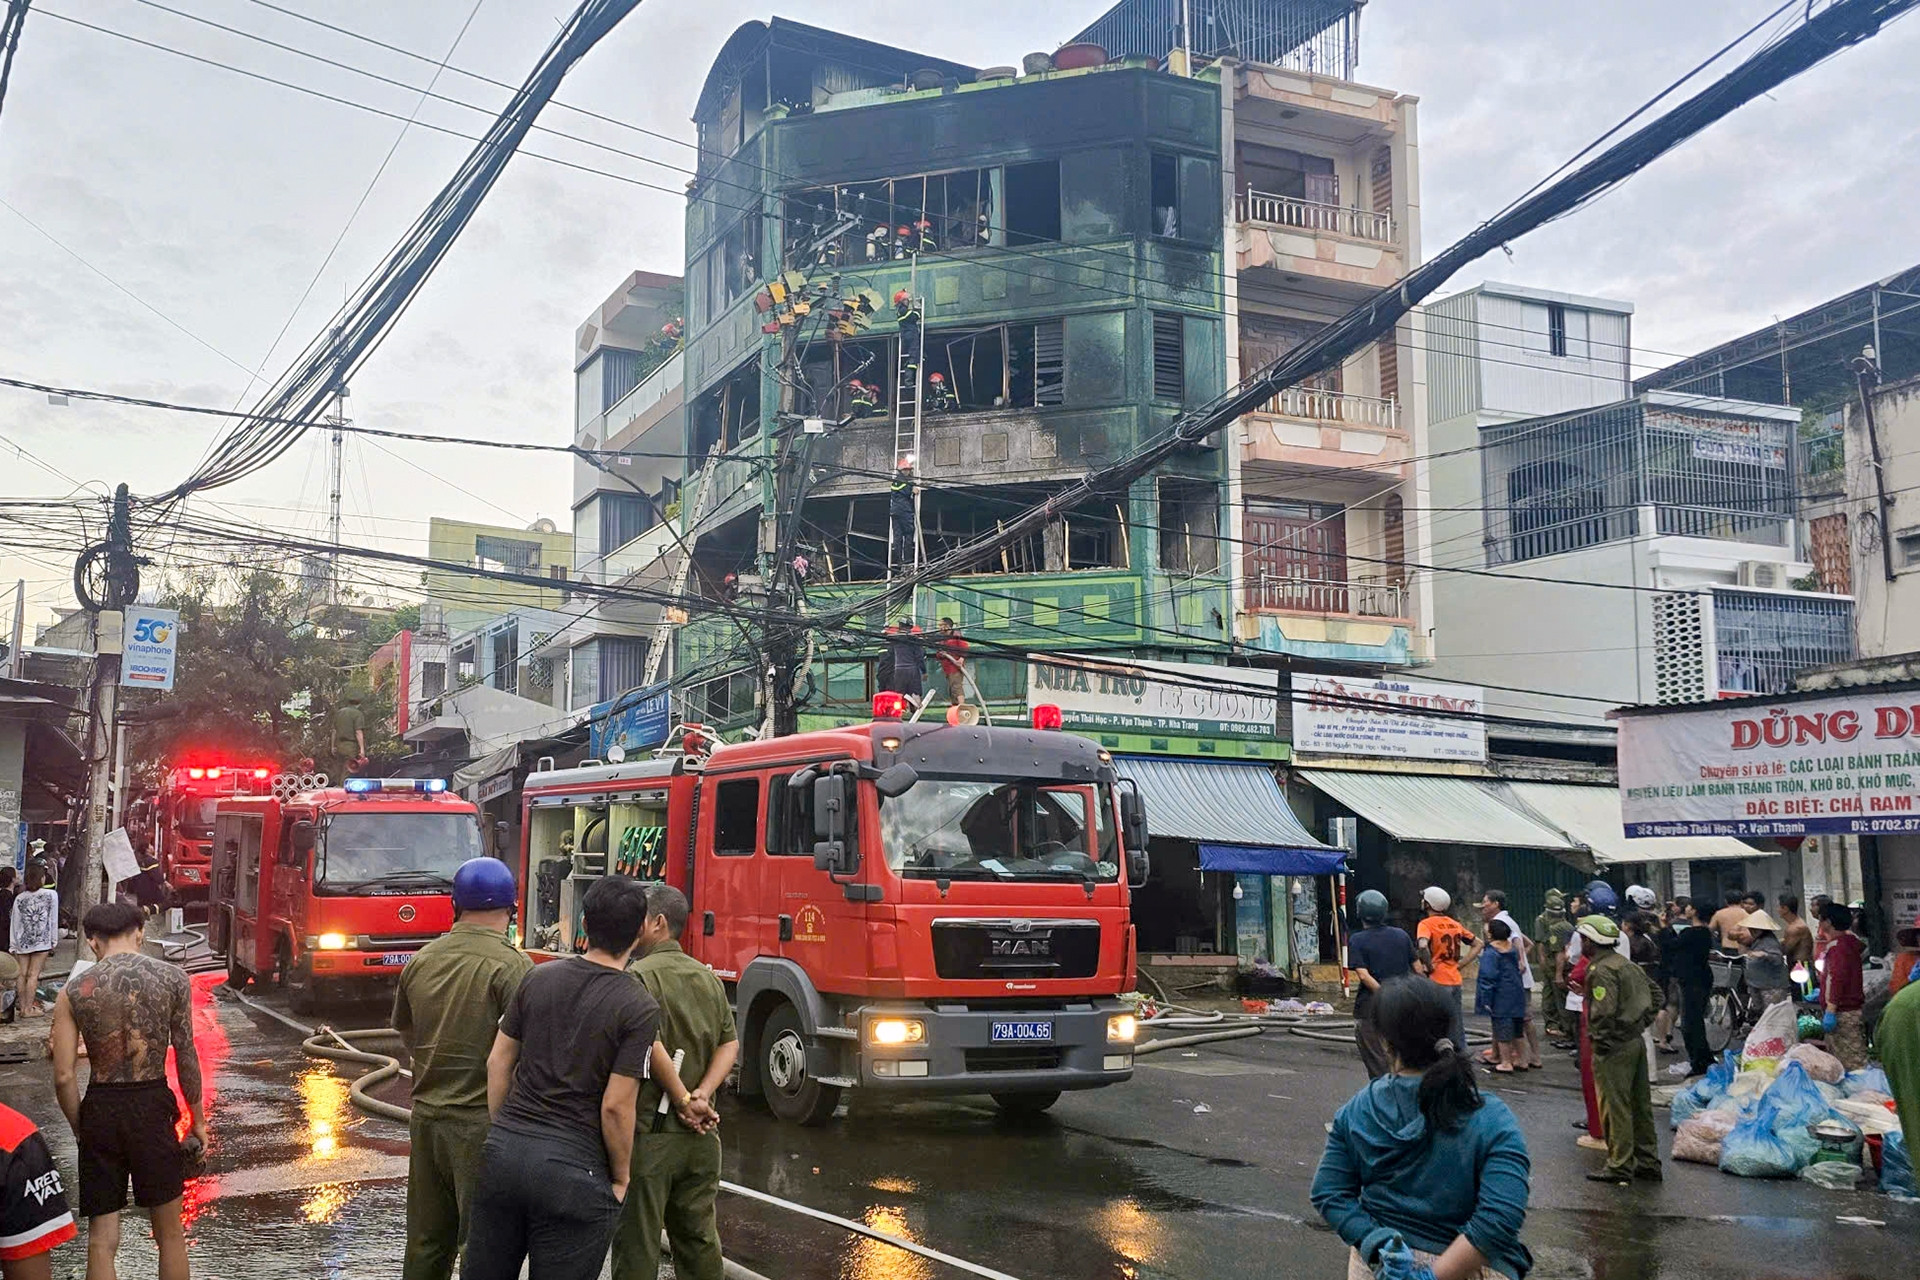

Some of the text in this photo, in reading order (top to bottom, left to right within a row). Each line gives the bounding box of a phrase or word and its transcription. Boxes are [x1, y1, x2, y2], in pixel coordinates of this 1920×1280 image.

[128, 644, 172, 655] vinaphone
[1034, 661, 1091, 693] NHÀ
[1096, 668, 1147, 705] TRỌ
[1081, 713, 1094, 723] Thái
[1095, 714, 1107, 725] Học
[1121, 717, 1133, 727] Vạn
[1134, 717, 1152, 728] Thạnh
[1169, 720, 1180, 728] Nha
[1181, 721, 1198, 730] Trang
[1731, 708, 1862, 750] DŨNG
[1700, 764, 1738, 778] Chuyên
[1756, 762, 1768, 775] và
[1789, 757, 1813, 773] CÁC
[1817, 756, 1844, 774] LOẠI
[1848, 753, 1882, 769] BÁNH
[1662, 782, 1683, 798] LIỆU
[1686, 783, 1705, 796] LÀM
[1709, 782, 1735, 796] BÁNH
[1737, 779, 1772, 794] TRÁNG
[1776, 777, 1807, 795] TRỘN,
[1810, 776, 1832, 791] KHÔ
[1836, 774, 1855, 790] BÒ,
[1858, 773, 1881, 789] KHÔ
[1885, 773, 1915, 790] MỰC,
[1746, 792, 1912, 818] ĐẶC BIỆT: CHẢ RAM
[1691, 823, 1712, 834] Thái
[1739, 824, 1747, 833] P.
[1750, 823, 1770, 837] Vạn
[1772, 822, 1805, 835] Thạnh
[992, 940, 1049, 954] MAN
[33, 1181, 64, 1206] VAL
